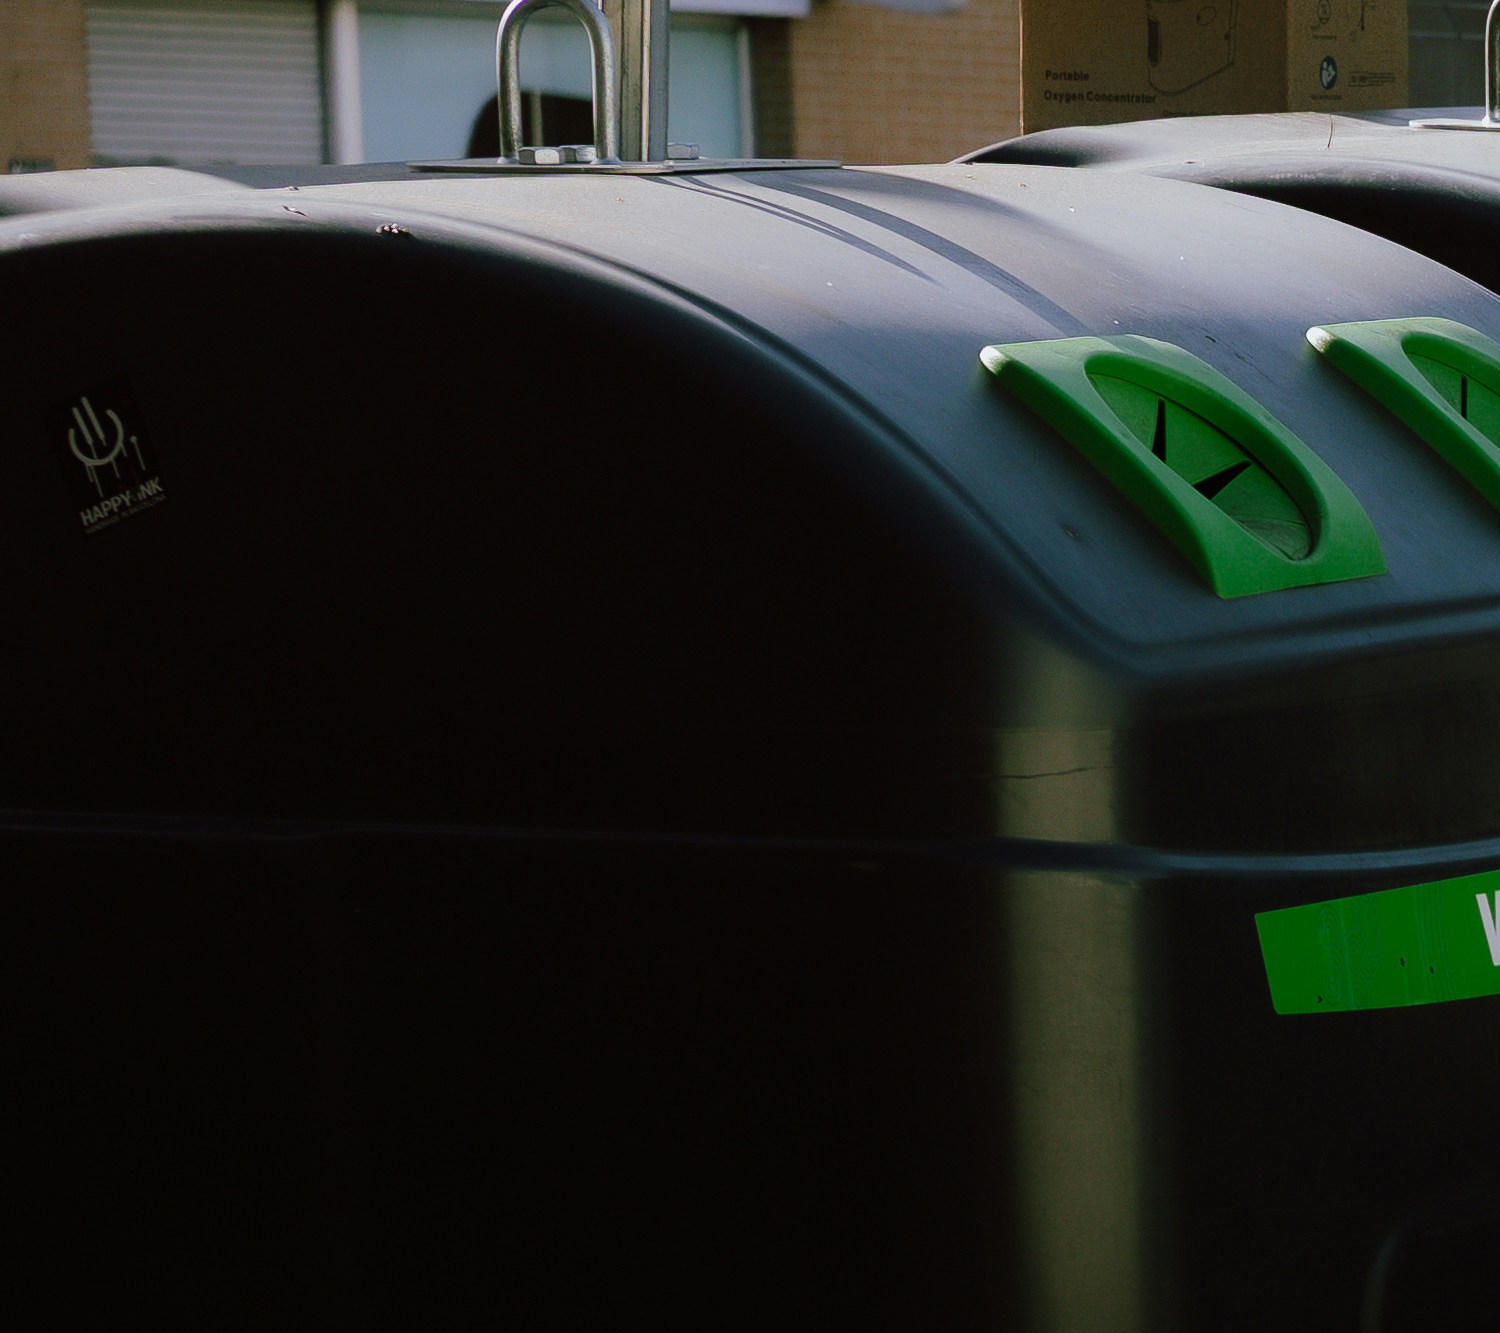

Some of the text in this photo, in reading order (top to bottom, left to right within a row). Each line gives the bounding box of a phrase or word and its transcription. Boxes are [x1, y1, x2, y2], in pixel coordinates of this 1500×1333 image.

[1045, 69, 1089, 82] Portable
[1044, 90, 1156, 104] Oxygen Concentrator
[79, 489, 132, 527] HAPPY
